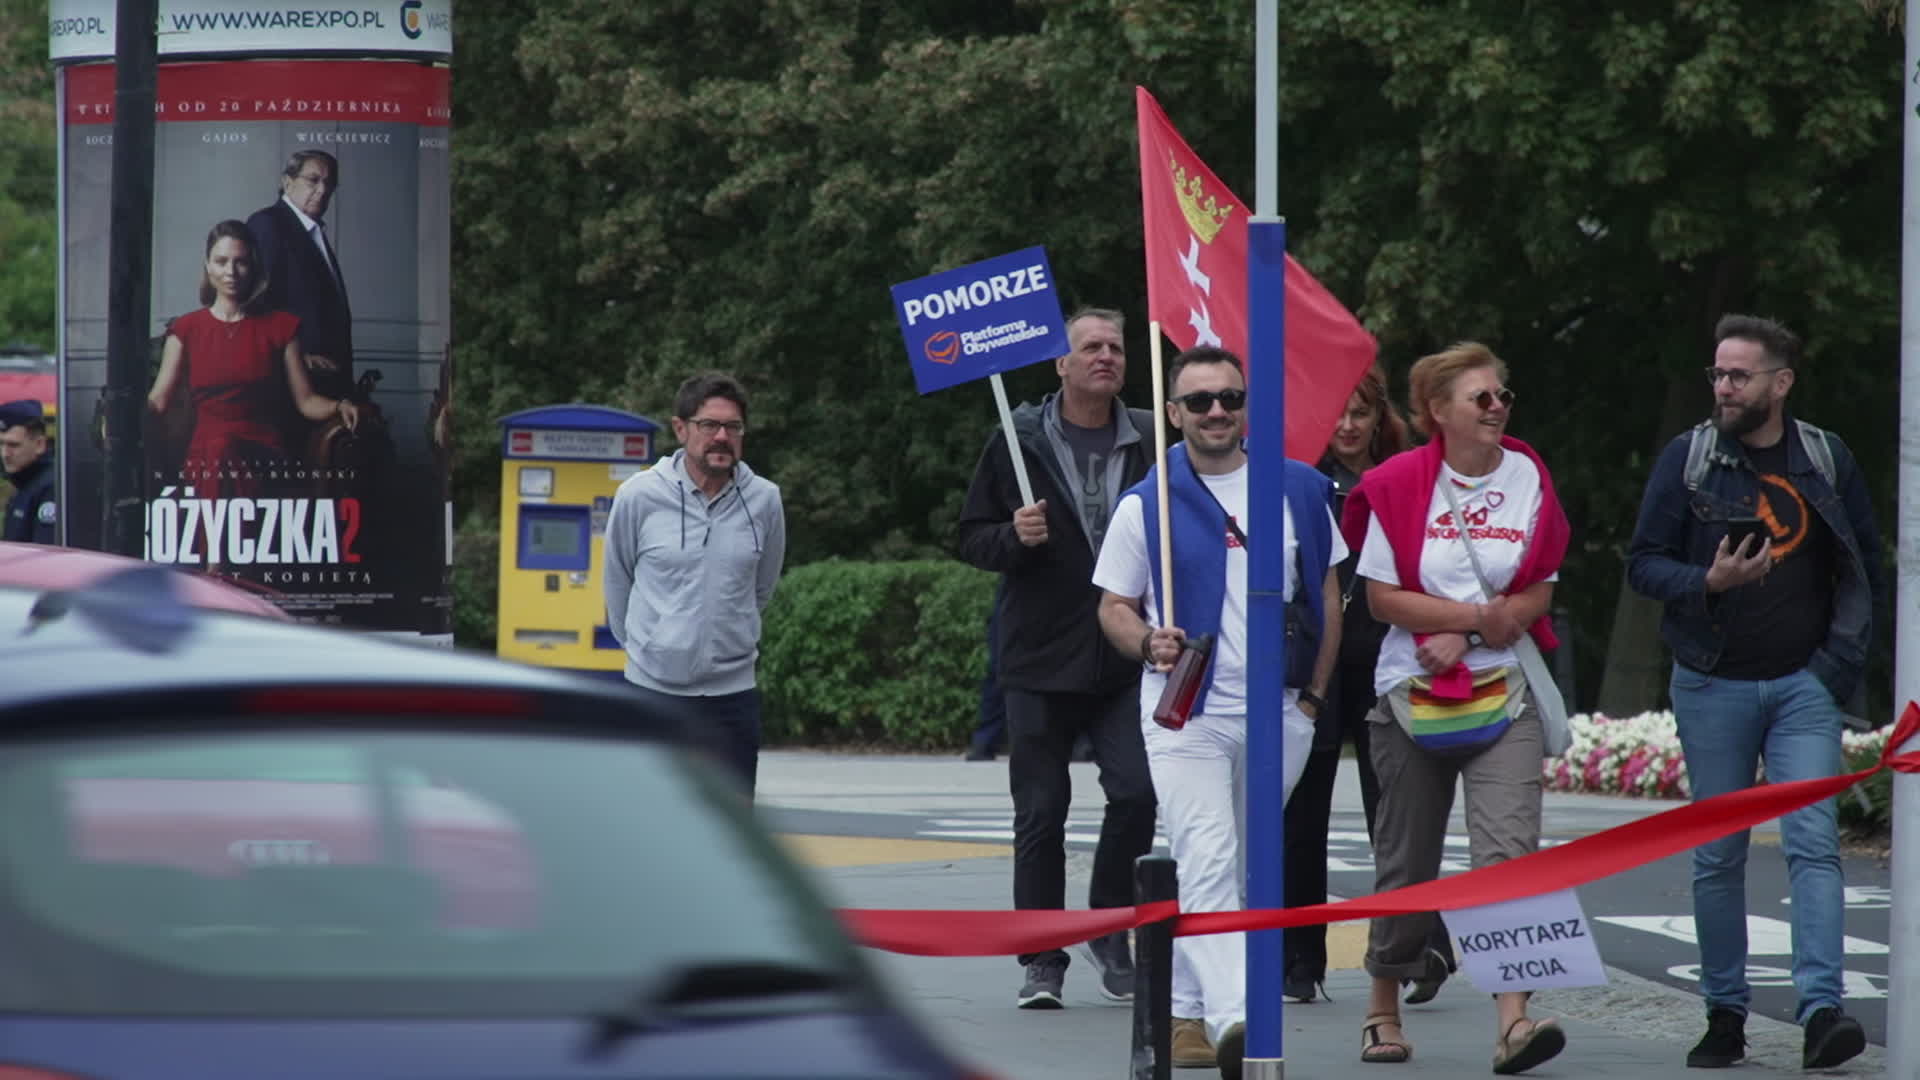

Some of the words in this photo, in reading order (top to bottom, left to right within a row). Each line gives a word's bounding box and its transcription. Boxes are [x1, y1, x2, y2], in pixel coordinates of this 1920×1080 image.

[172, 10, 385, 31] WWW.WAREXPO.PL
[177, 101, 206, 113] OD
[219, 101, 240, 113] 20
[254, 98, 401, 113] PAŹDZIERNIKA
[201, 131, 249, 144] GAJOS
[903, 264, 1049, 326] POMORZE
[960, 319, 1027, 345] Platforma
[963, 325, 1049, 356] Obywatelska
[144, 486, 339, 565] ÓŻYCZKA
[263, 571, 372, 585] KOBIETĄ
[1458, 918, 1585, 954] KORYTARZ
[1498, 957, 1568, 982] ŻYCIA
